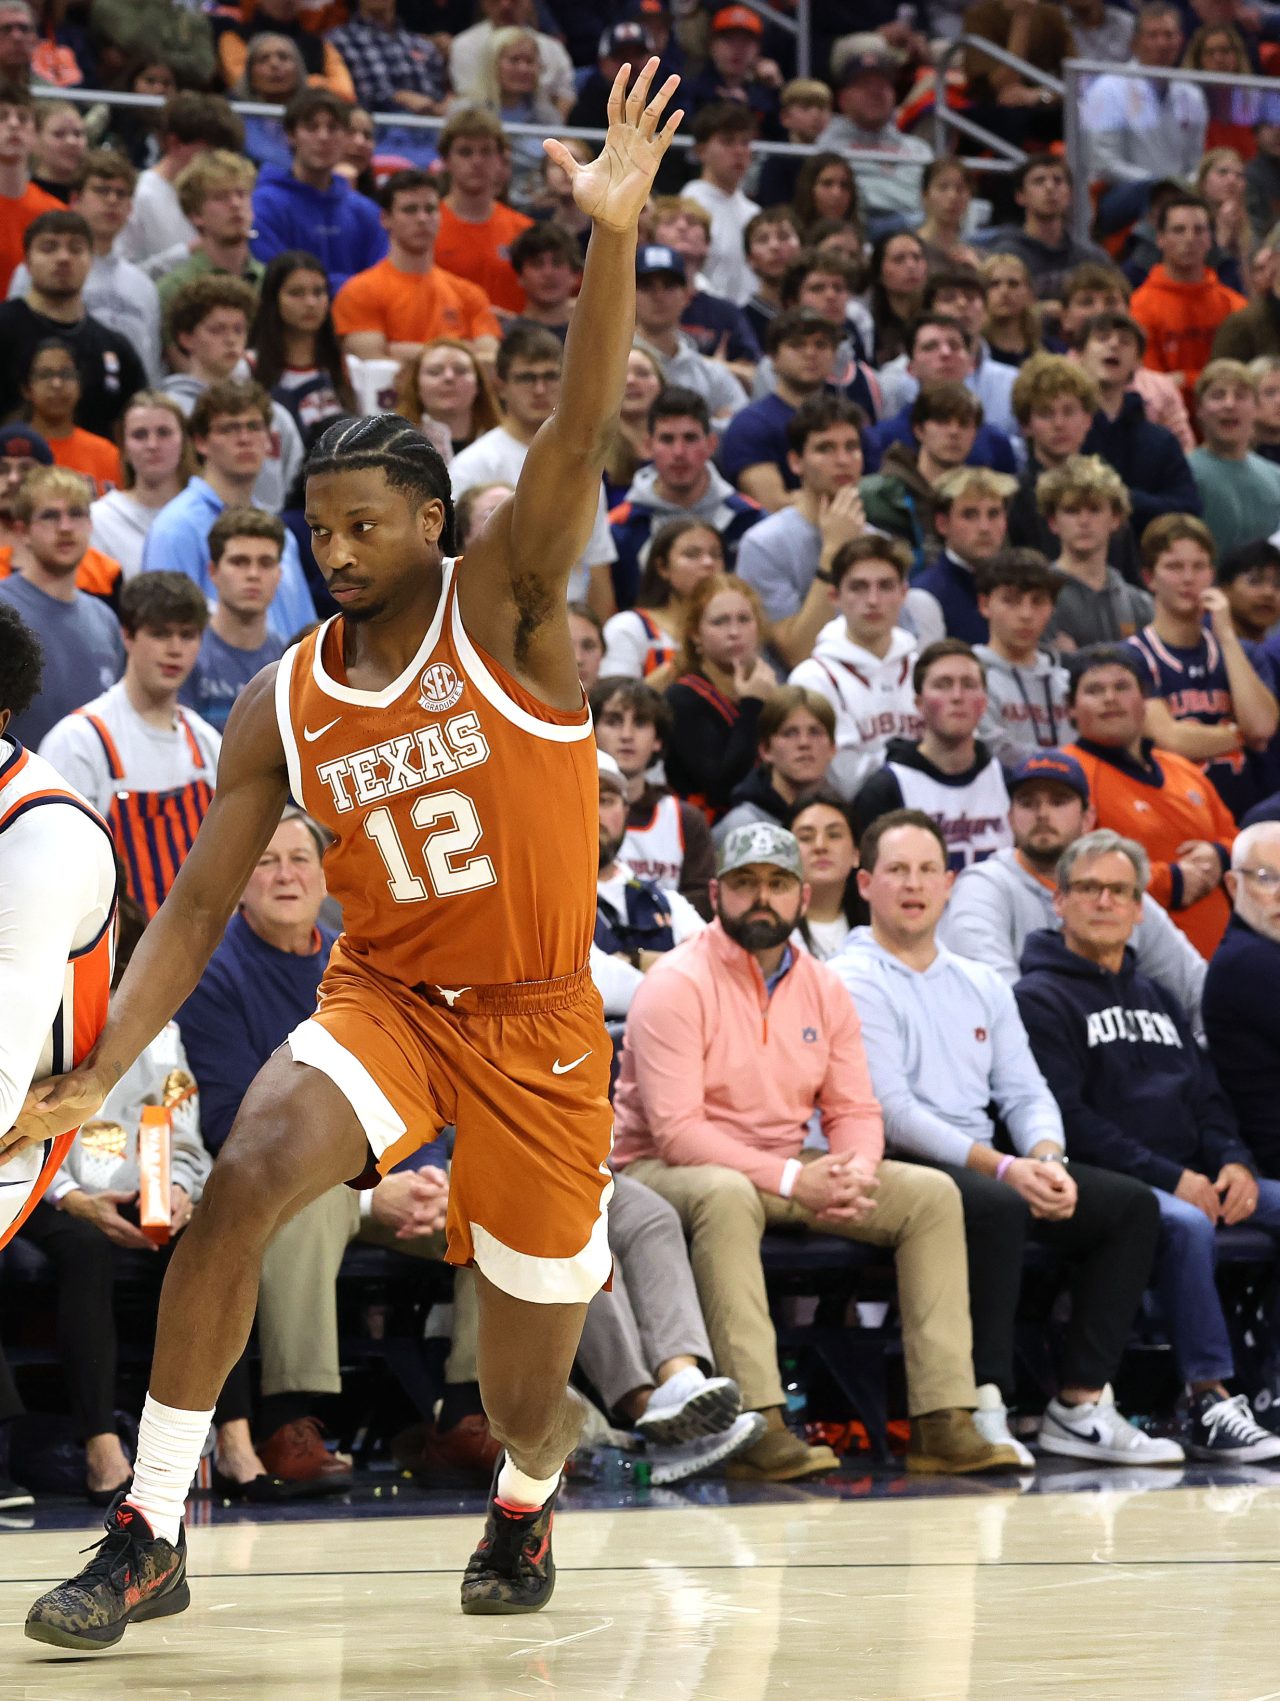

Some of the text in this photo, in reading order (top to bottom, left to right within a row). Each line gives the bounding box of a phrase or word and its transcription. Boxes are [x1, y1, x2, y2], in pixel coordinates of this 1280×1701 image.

[422, 665, 456, 700] SEC
[423, 689, 462, 712] GRADUATE
[316, 710, 491, 814] TEXAS
[363, 788, 498, 904] 12
